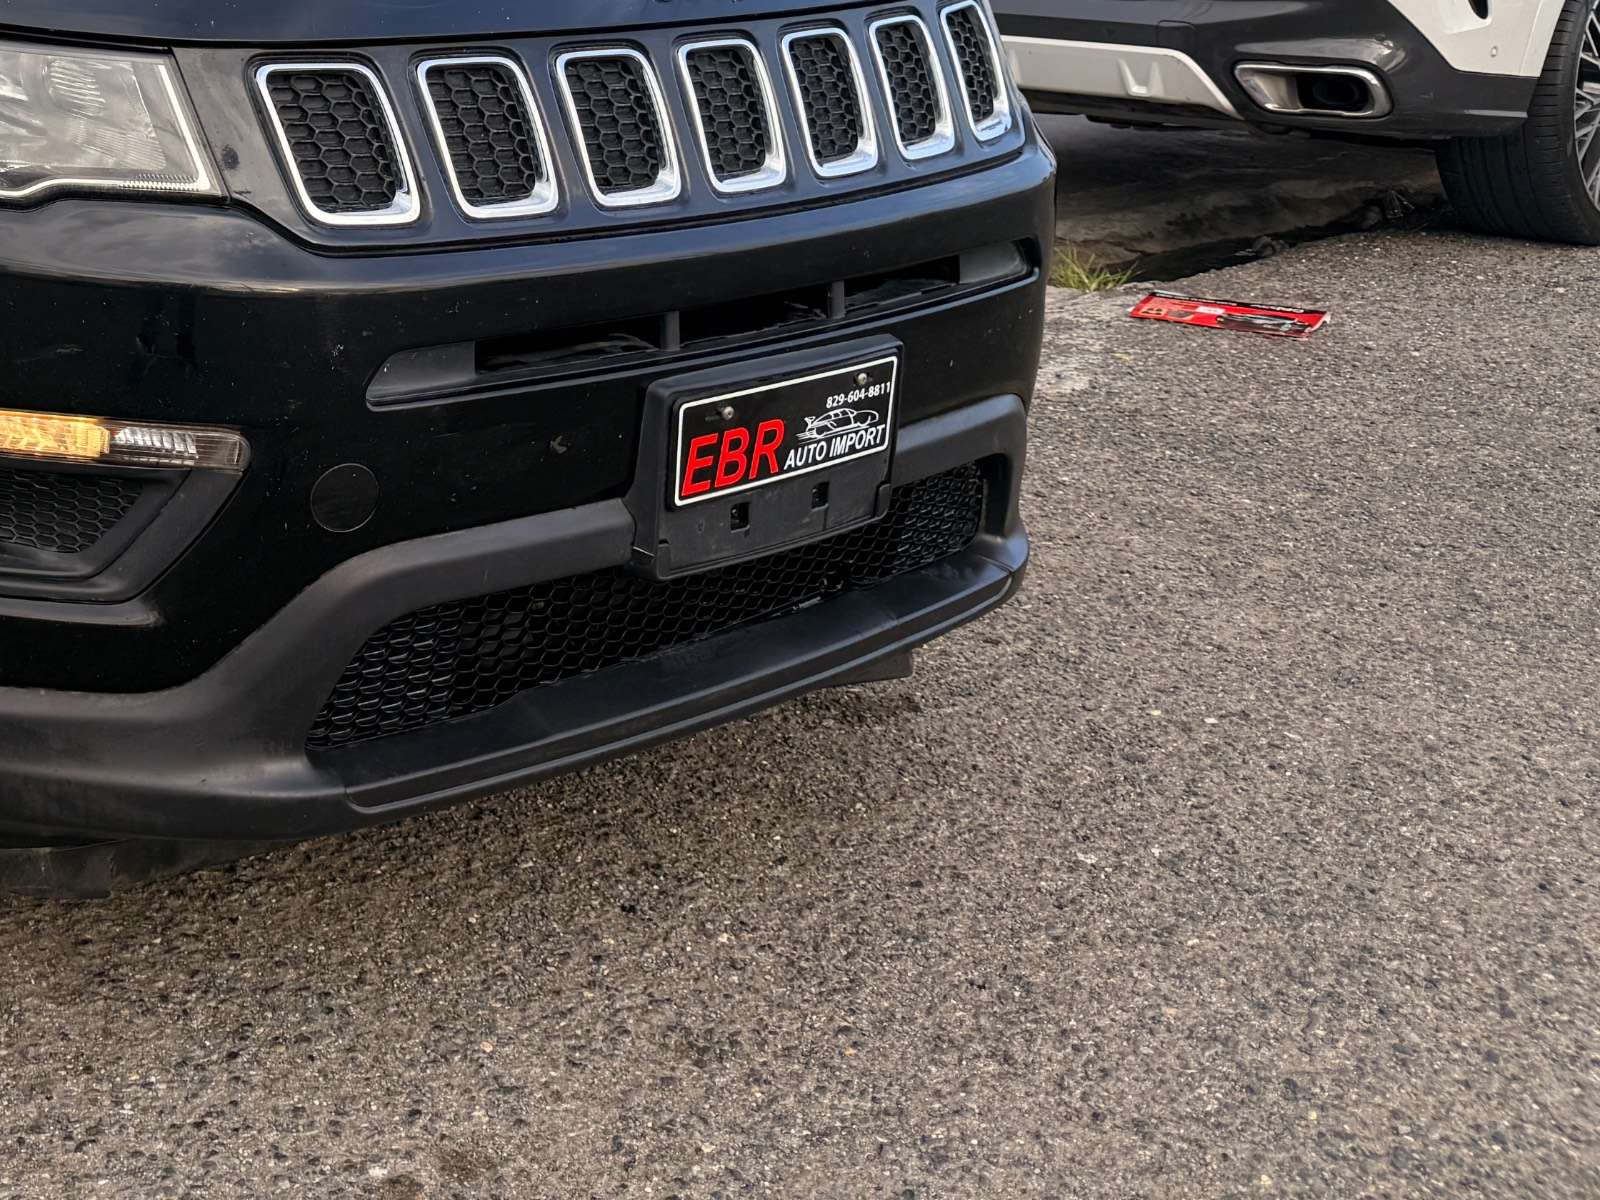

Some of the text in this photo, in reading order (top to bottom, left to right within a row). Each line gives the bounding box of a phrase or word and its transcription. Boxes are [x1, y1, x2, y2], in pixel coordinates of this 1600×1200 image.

[826, 382, 891, 409] 829-604-8811
[681, 419, 886, 497] EBR AUTO IMPORT
